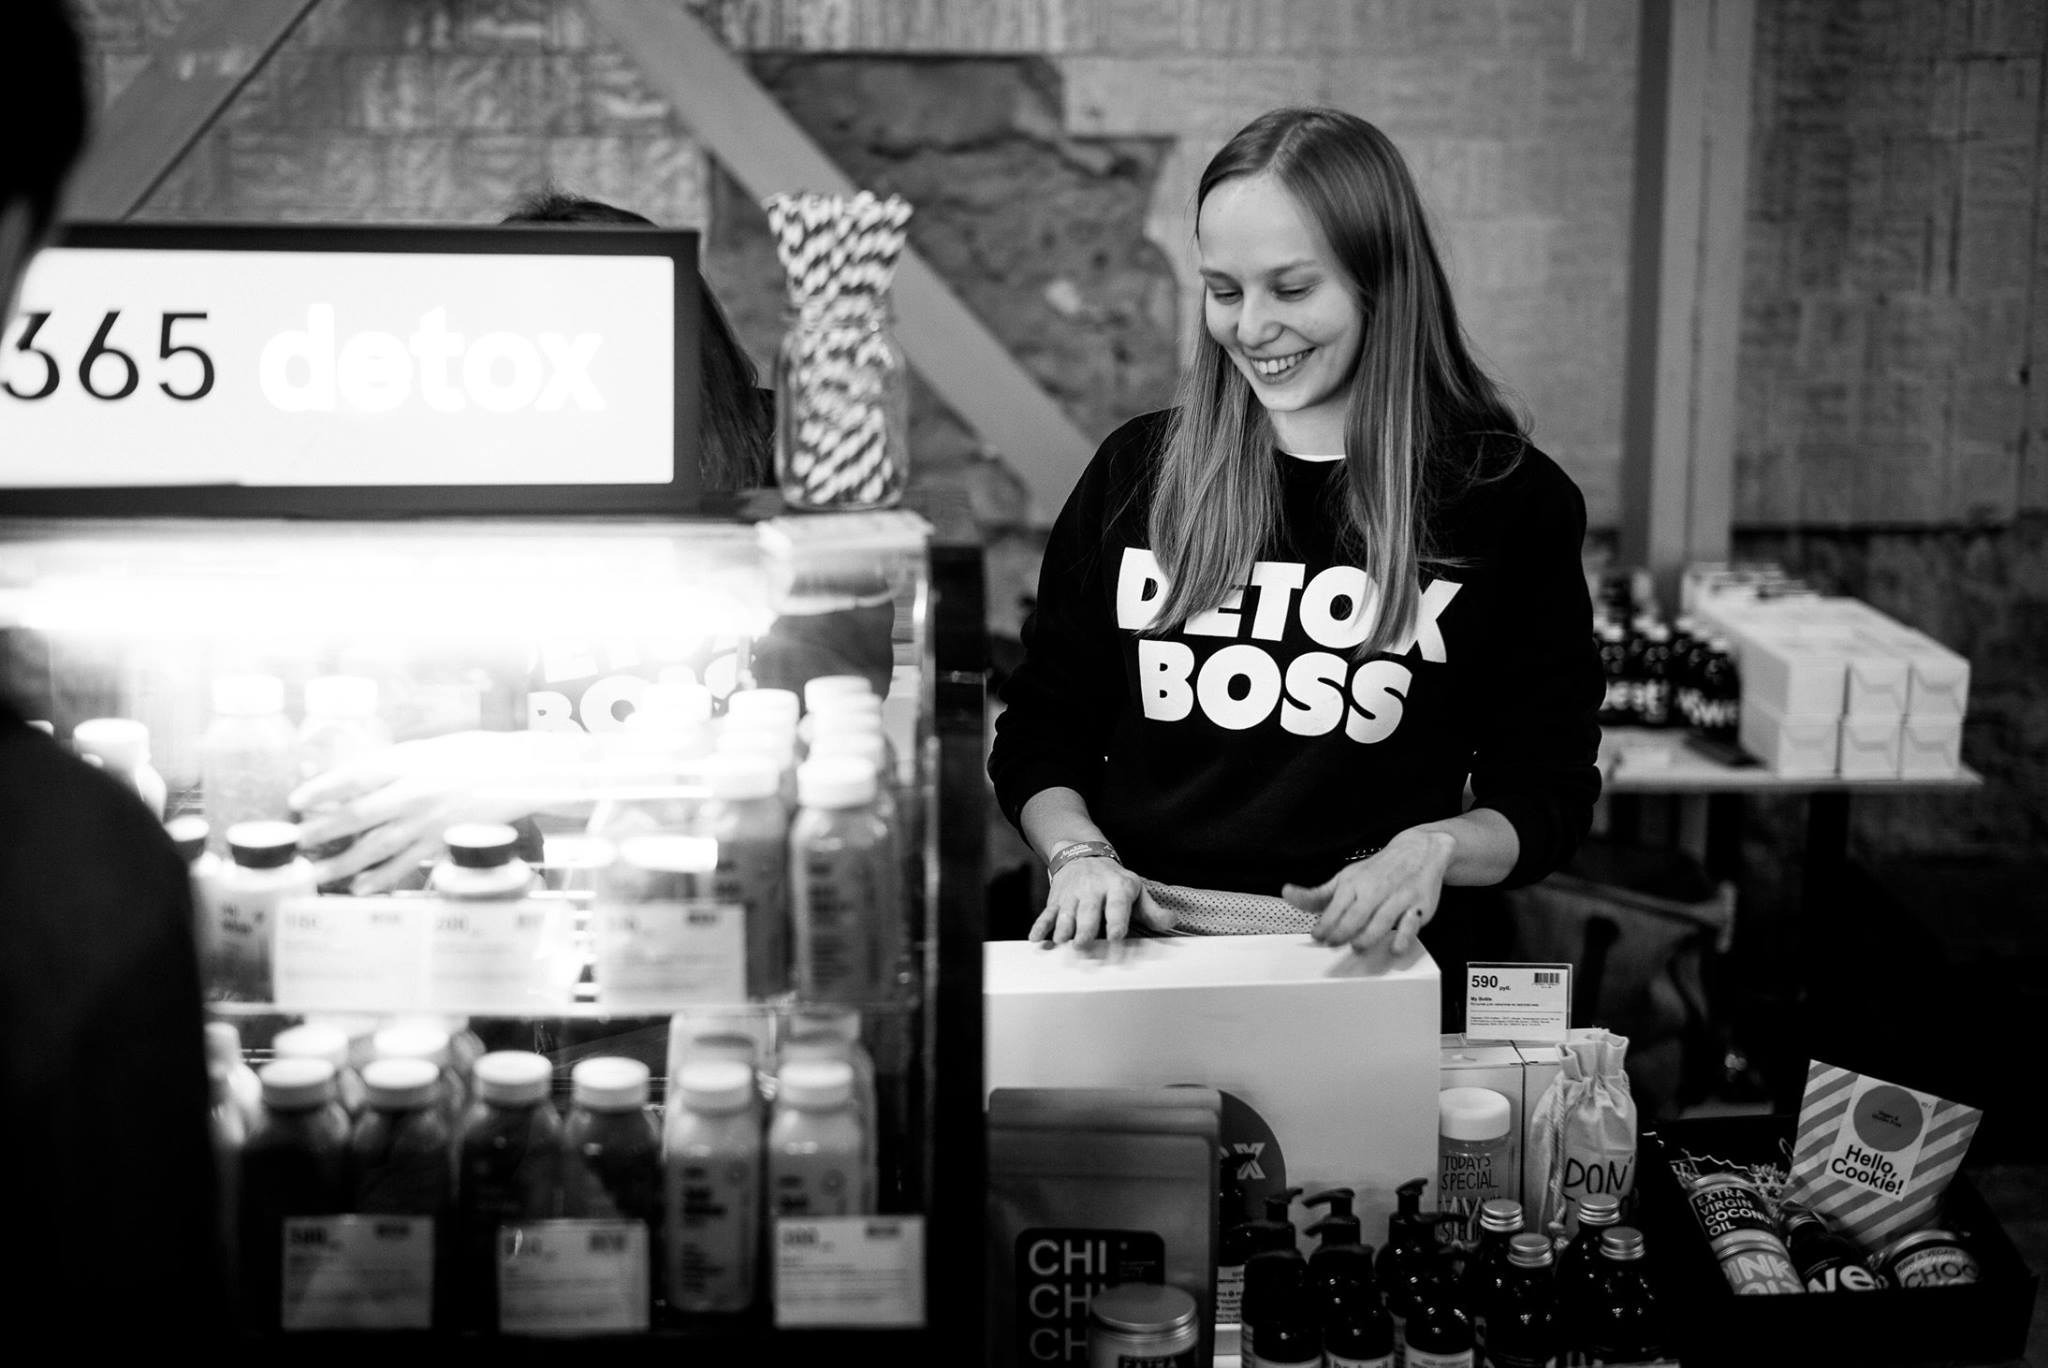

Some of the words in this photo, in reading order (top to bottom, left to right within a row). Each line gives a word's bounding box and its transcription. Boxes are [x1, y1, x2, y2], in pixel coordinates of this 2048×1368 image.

[1, 310, 215, 401] 365
[259, 303, 606, 413] detox
[1139, 639, 1412, 744] BOSS
[1471, 975, 1498, 988] 590
[1831, 1158, 1904, 1195] Cookie!
[1845, 1144, 1898, 1179] Hello,
[1440, 1168, 1499, 1192] SPECIAL
[1696, 1188, 1746, 1207] EXTRA
[1699, 1198, 1753, 1216] VIRGIN
[1709, 1222, 1737, 1237] OIL
[1028, 1238, 1107, 1276] CHI
[1722, 1254, 1799, 1284] INK
[1028, 1282, 1107, 1319] CH
